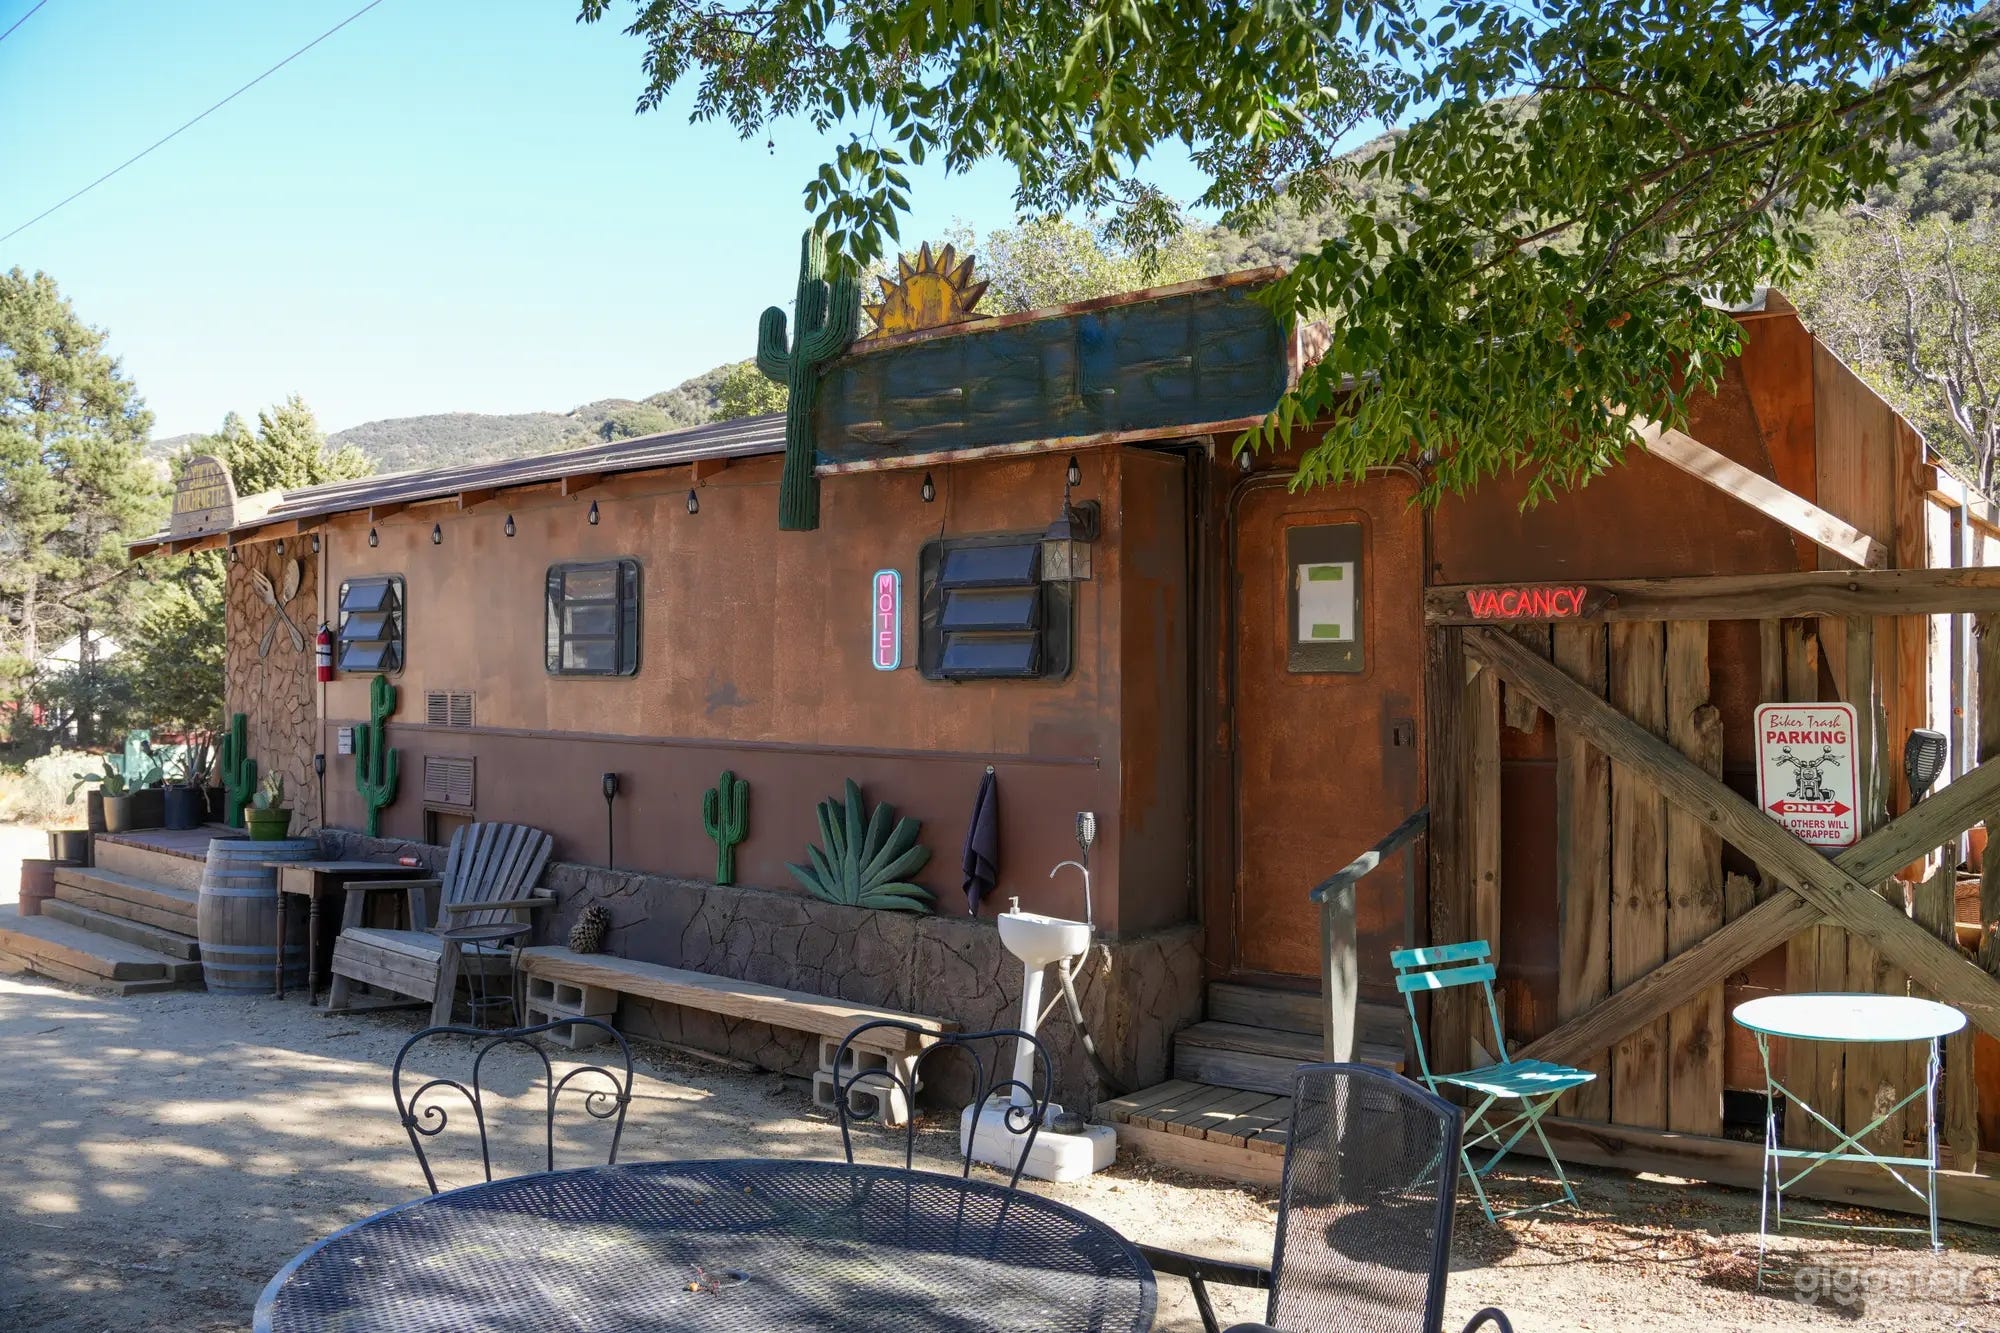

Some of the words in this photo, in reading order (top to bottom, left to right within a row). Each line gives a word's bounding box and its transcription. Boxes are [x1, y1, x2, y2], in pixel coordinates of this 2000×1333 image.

[1468, 588, 1585, 616] VACANCY
[879, 574, 893, 666] MOTEL
[1770, 714, 1803, 728] Biker
[1807, 715, 1841, 728] Trash
[1766, 731, 1847, 744] PARKING
[1783, 804, 1836, 813] ONLY
[1791, 819, 1826, 829] OTHERS
[1827, 820, 1849, 829] WILL
[1795, 829, 1841, 839] SCRAPPED
